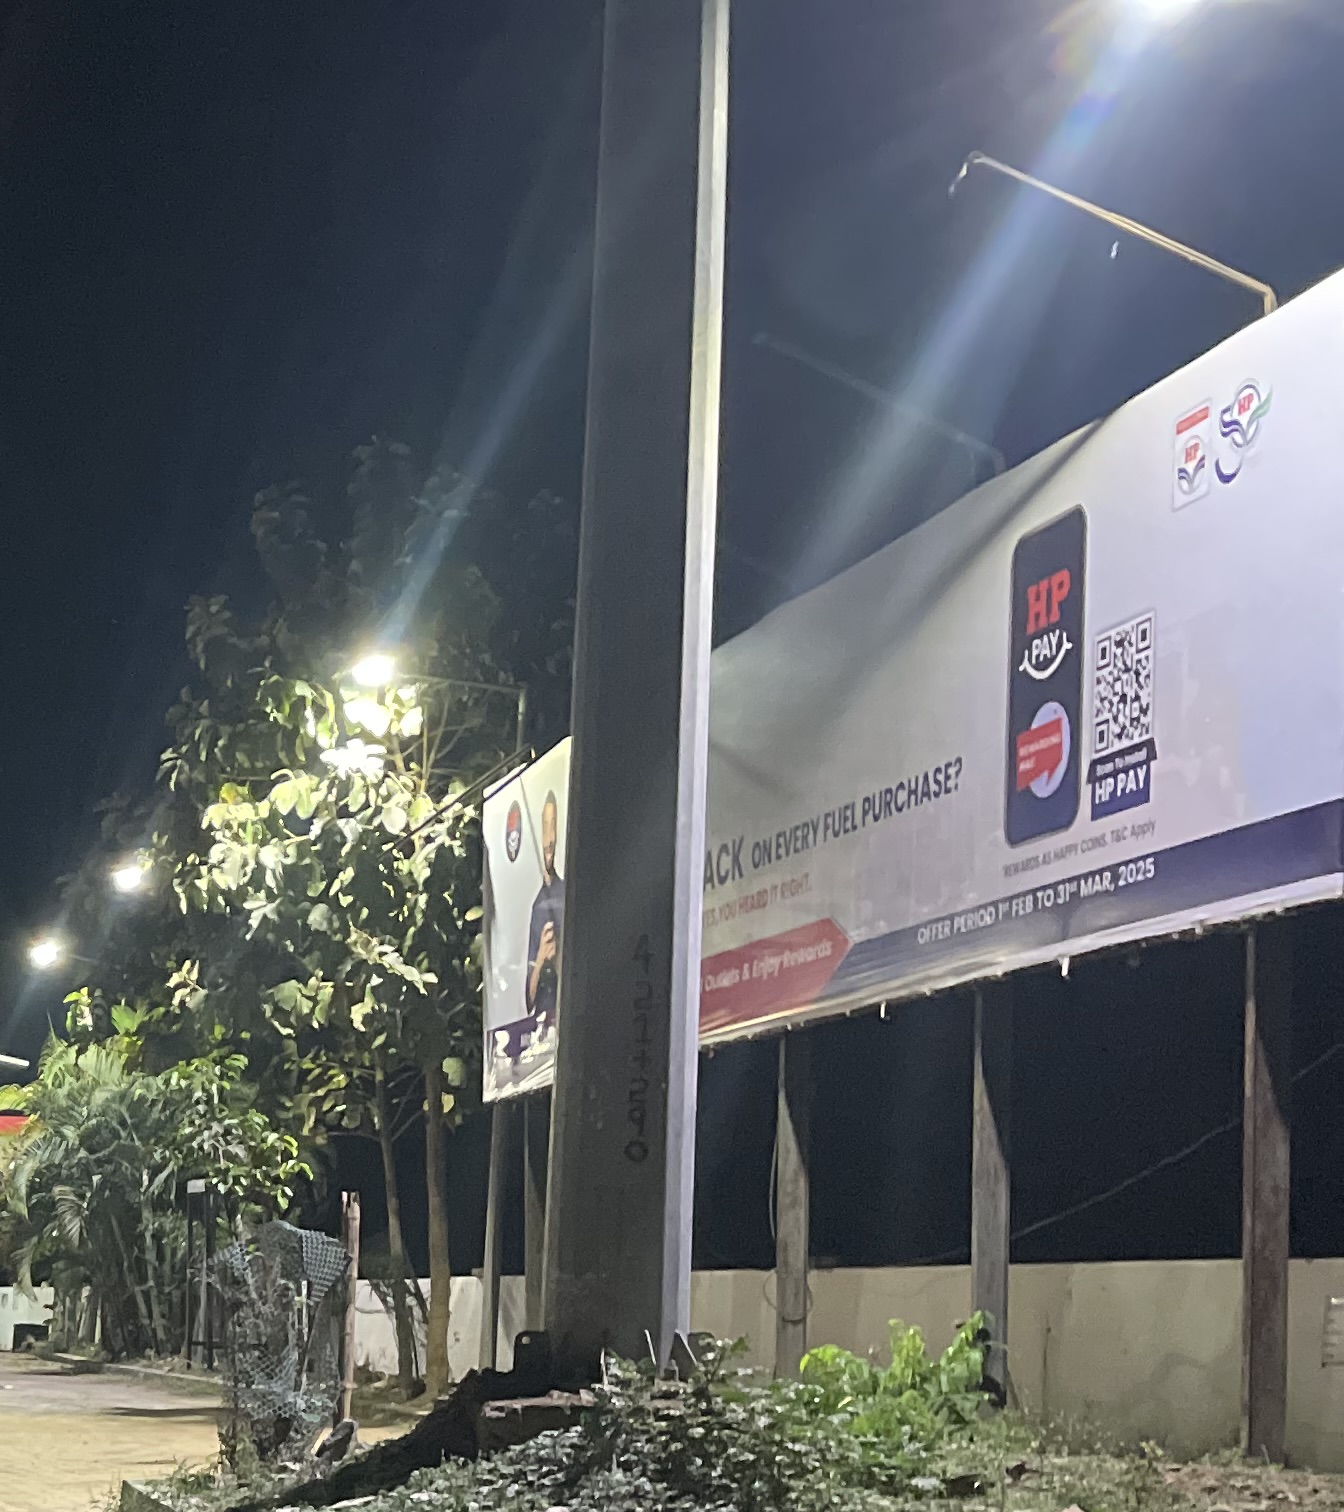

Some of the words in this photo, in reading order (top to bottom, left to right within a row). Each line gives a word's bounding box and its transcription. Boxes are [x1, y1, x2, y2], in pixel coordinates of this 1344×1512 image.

[1238, 393, 1254, 416] HP
[1183, 442, 1200, 465] HP
[1026, 568, 1071, 635] HP
[1031, 629, 1060, 664] PAY
[1095, 777, 1115, 804] HP
[1116, 764, 1147, 797] PAY
[703, 835, 744, 892] ACK
[752, 836, 772, 869] ON
[775, 815, 821, 860] EVERY
[823, 802, 857, 842] FUEL
[862, 756, 962, 827] PURCHASE?
[1130, 818, 1157, 842] Apply
[719, 901, 737, 921] YOU
[738, 889, 769, 915] HEARD
[770, 884, 778, 904] IT
[917, 922, 951, 944] OFFER
[953, 906, 996, 933] PERIOD
[1012, 895, 1034, 917] FEB
[1036, 889, 1054, 908] TO
[1080, 871, 1115, 898] MAR,
[1118, 857, 1156, 887] 2025
[742, 963, 751, 980] &
[752, 955, 781, 979] Enjoy
[782, 939, 834, 968] Rewards
